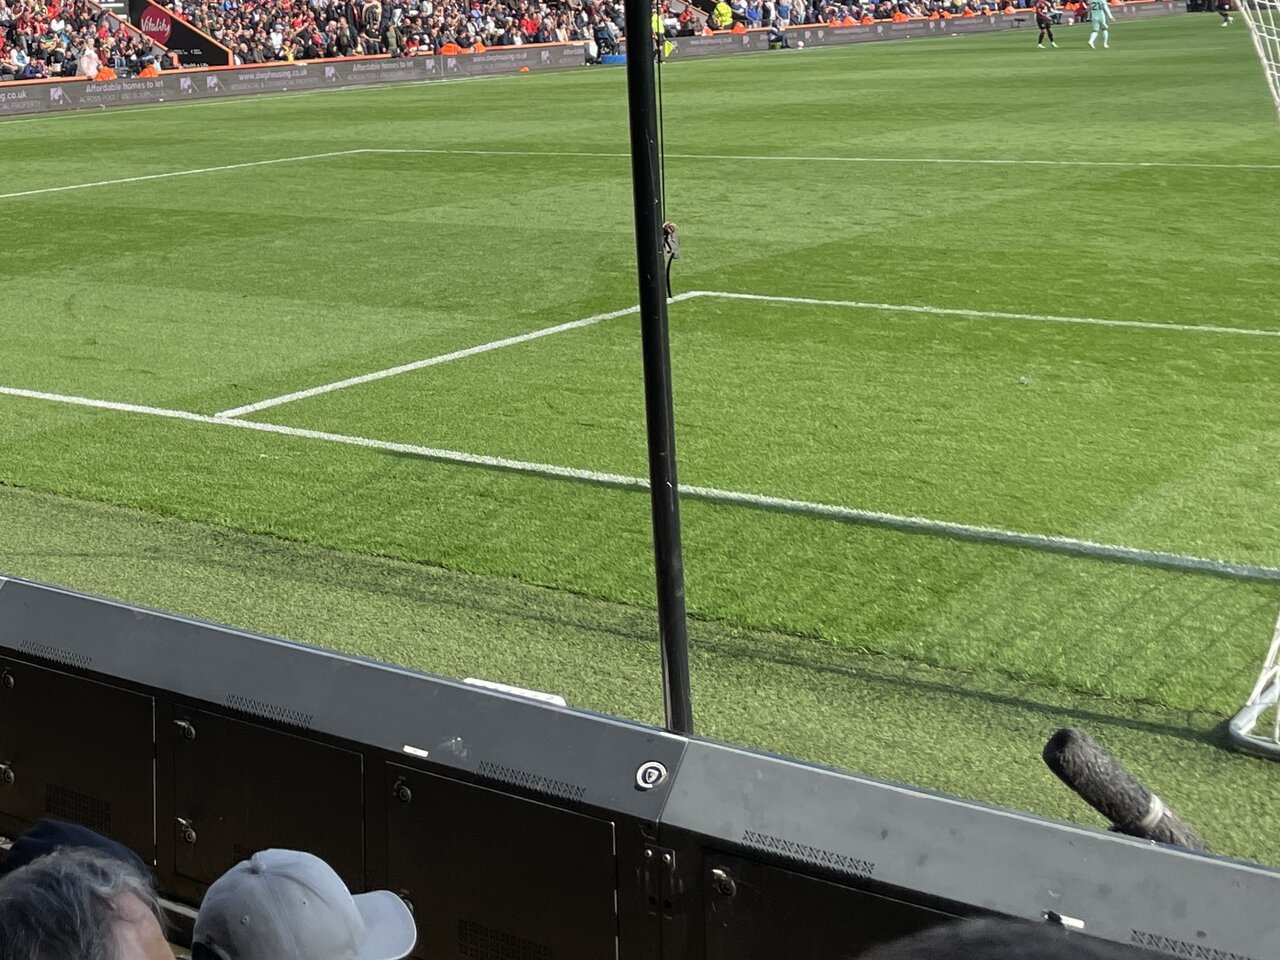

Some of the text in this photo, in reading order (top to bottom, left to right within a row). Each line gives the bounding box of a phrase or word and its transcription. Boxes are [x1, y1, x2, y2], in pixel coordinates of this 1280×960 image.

[141, 15, 170, 36] Vitality
[86, 79, 163, 93] Affordable homes to let
